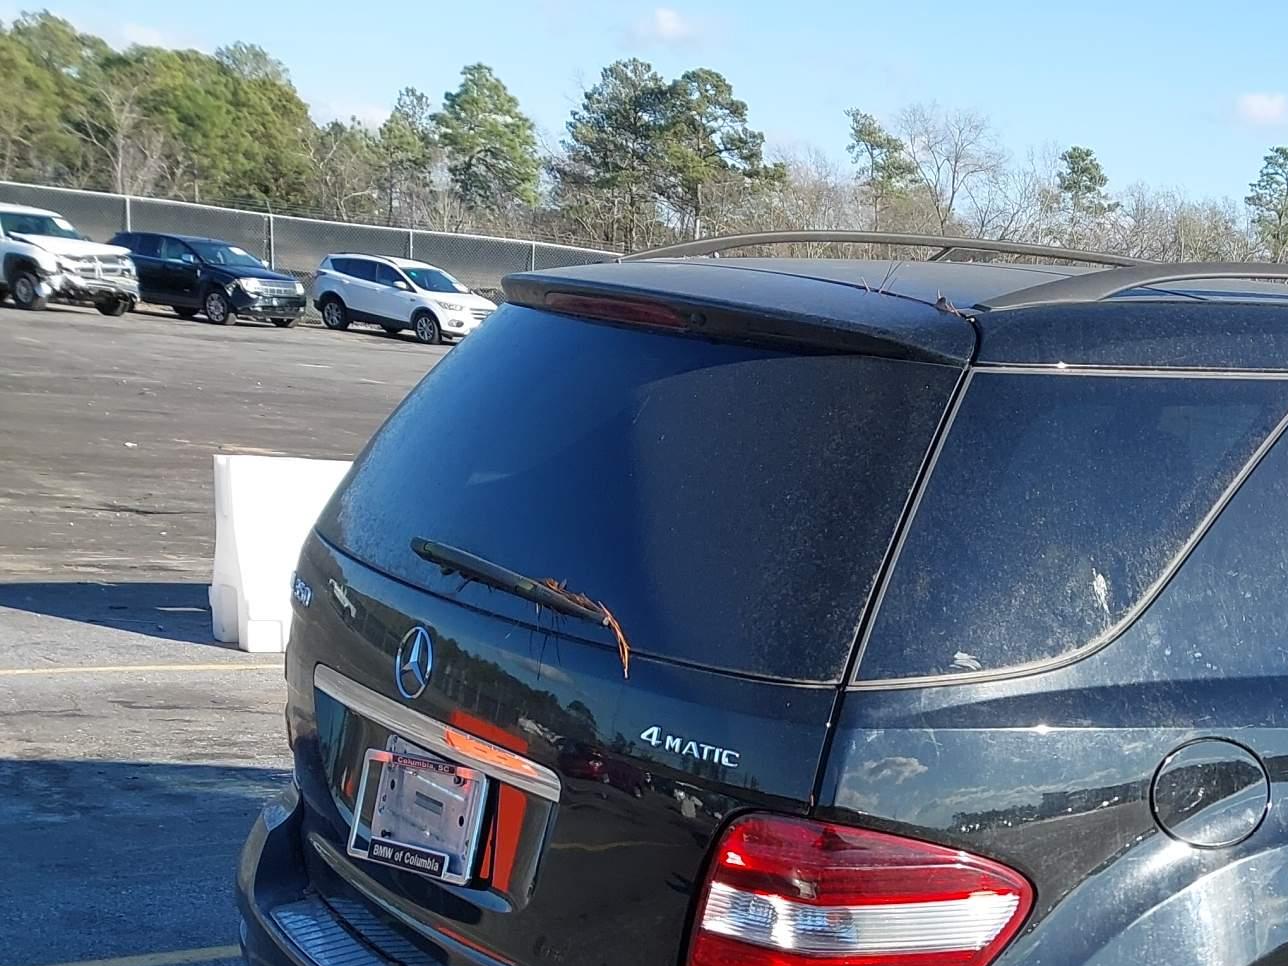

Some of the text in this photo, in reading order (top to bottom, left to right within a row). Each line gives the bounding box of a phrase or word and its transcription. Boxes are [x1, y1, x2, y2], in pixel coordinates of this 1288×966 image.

[397, 757, 450, 773] Columbia, SC
[373, 844, 439, 872] BMW of Columbia
